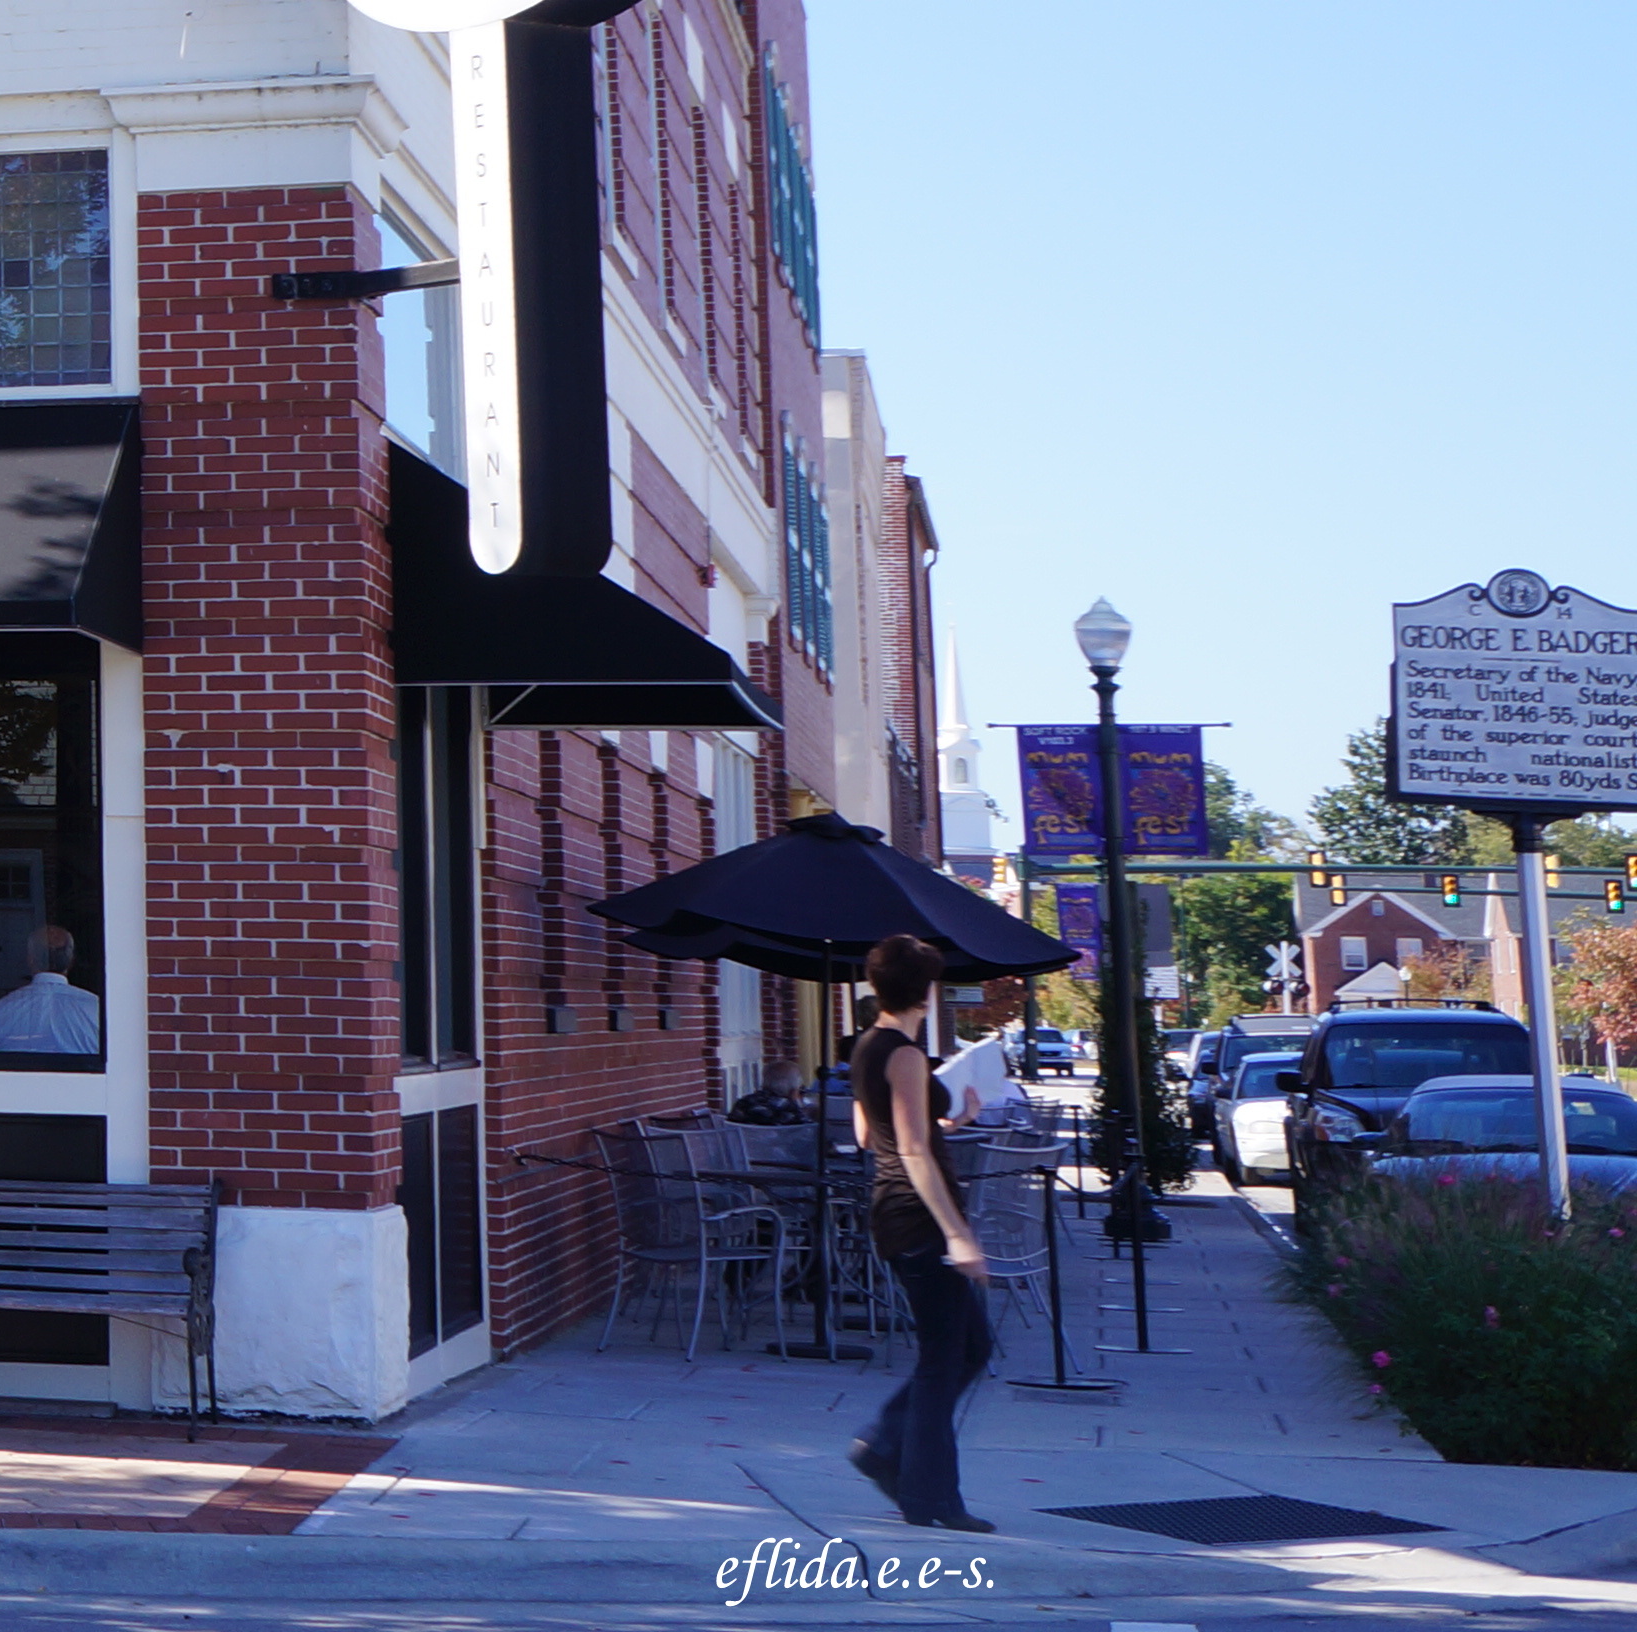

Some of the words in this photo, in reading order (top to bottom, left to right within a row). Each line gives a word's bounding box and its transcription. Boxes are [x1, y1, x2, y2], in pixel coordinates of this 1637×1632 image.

[470, 54, 502, 529] RESTAURANT
[1468, 604, 1482, 617] C
[1556, 607, 1573, 619] 14
[1400, 625, 1500, 651] GEORGE
[1537, 629, 1637, 655] BADGER
[1405, 660, 1511, 685] Secretary
[1519, 666, 1539, 683] of
[1545, 667, 1579, 684] the
[1475, 685, 1544, 703] United
[1407, 701, 1488, 723] Senator,
[1583, 710, 1637, 730] judge
[1407, 724, 1429, 740] of
[1440, 725, 1473, 742] the
[1485, 730, 1571, 747] superior
[1408, 746, 1488, 763] staunch
[1407, 763, 1509, 786] Birthplace
[1513, 773, 1550, 787] was
[1559, 770, 1621, 792] 80yds
